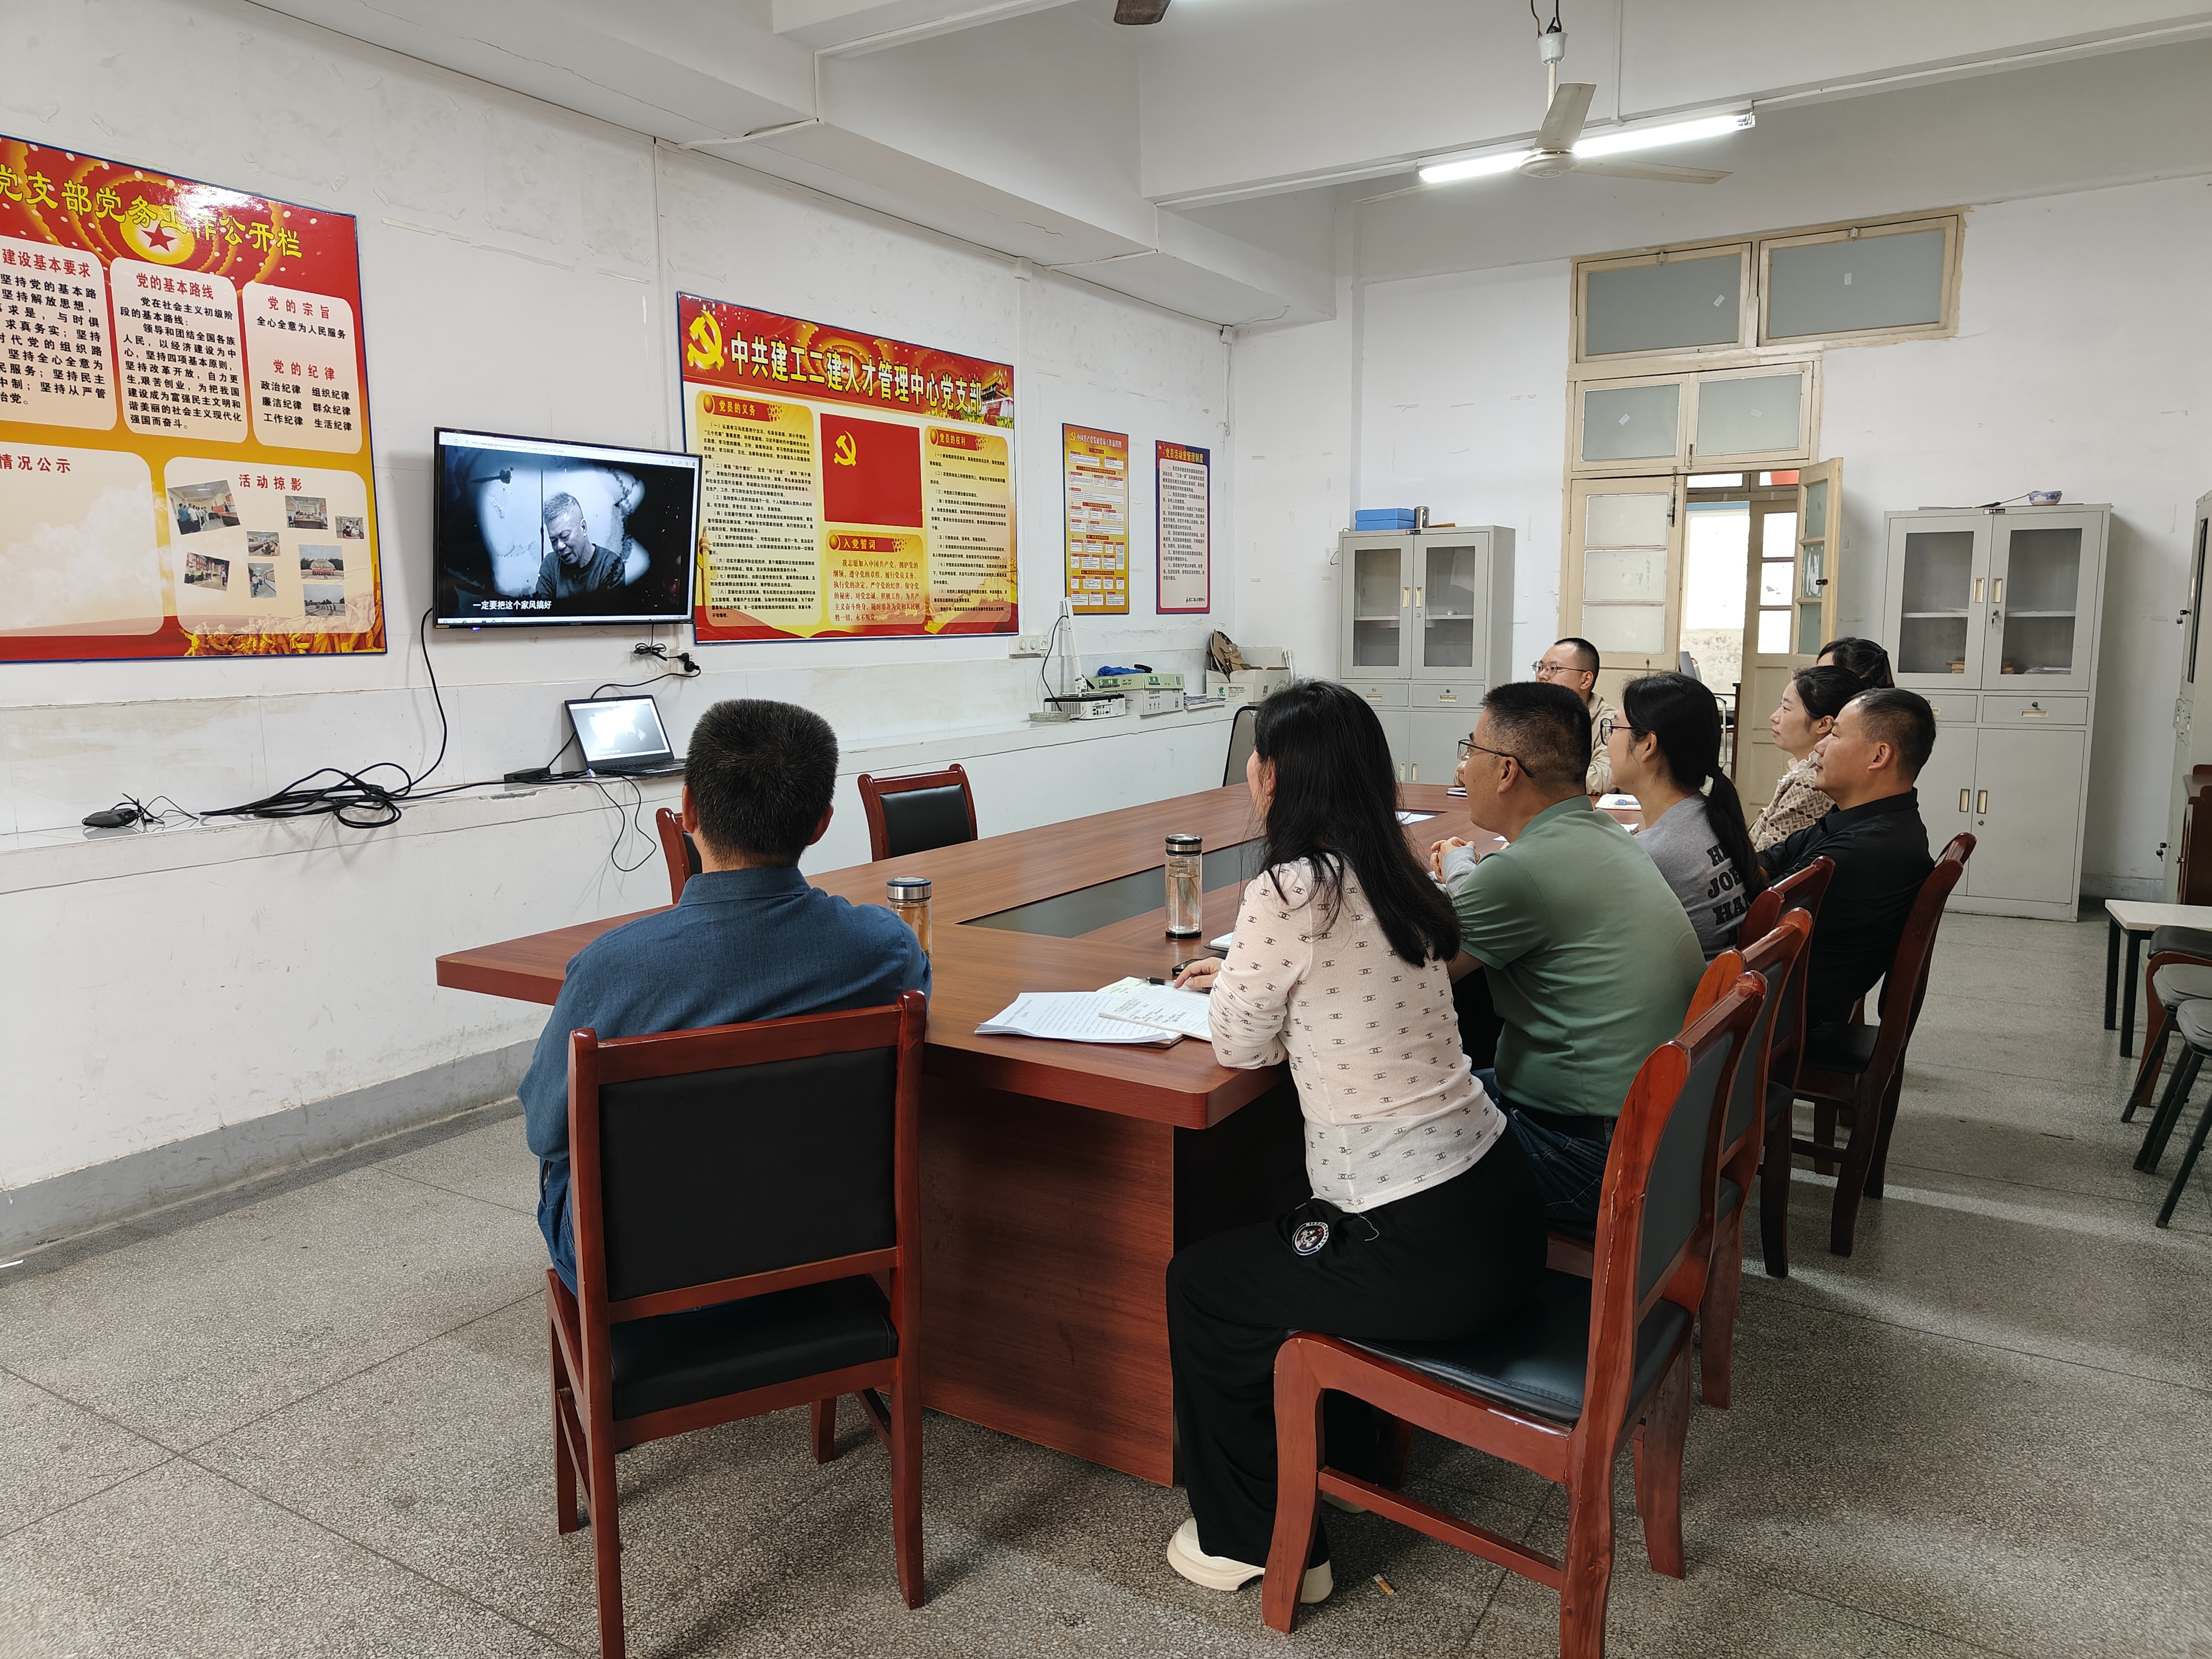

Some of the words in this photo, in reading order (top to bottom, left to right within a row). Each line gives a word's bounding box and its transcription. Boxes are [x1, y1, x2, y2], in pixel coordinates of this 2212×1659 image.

[2, 248, 91, 278] 建设基本要求
[0, 273, 97, 300] 坚持党的基本路
[136, 272, 214, 300] 党的基本路线
[0, 302, 99, 328] 求是，与时俱
[140, 296, 233, 320] 党在社会主义初级阶
[268, 295, 329, 319] 党的宗旨
[143, 323, 236, 346] 领导和团结全国各族
[257, 316, 346, 339] 全心全意为人民服务
[8, 348, 103, 370] 坚持全心全意为
[273, 359, 335, 381] 党的纪律
[731, 330, 982, 416] 中共建工二建人才管理中心党支部
[127, 387, 240, 409] 建设成为富强民主文明和
[260, 380, 301, 394] 政治纪律
[312, 387, 350, 401] 组织纪律
[129, 401, 242, 422] 谐美丽的社会主义现代化
[262, 396, 302, 410] 廉洁纪律
[312, 402, 351, 416] 群众纪律
[719, 400, 756, 416] 党员的义务
[263, 413, 304, 426] 工作纪律
[314, 418, 352, 431] 生活纪律
[940, 433, 966, 446] 党员的权利
[0, 453, 71, 473] 情况公示
[1165, 448, 1203, 463] 党员活动室管理制度
[239, 474, 302, 491] 活动掠影
[843, 538, 875, 550] 入党誓词
[473, 600, 552, 610] 一定要把这个家风搞好
